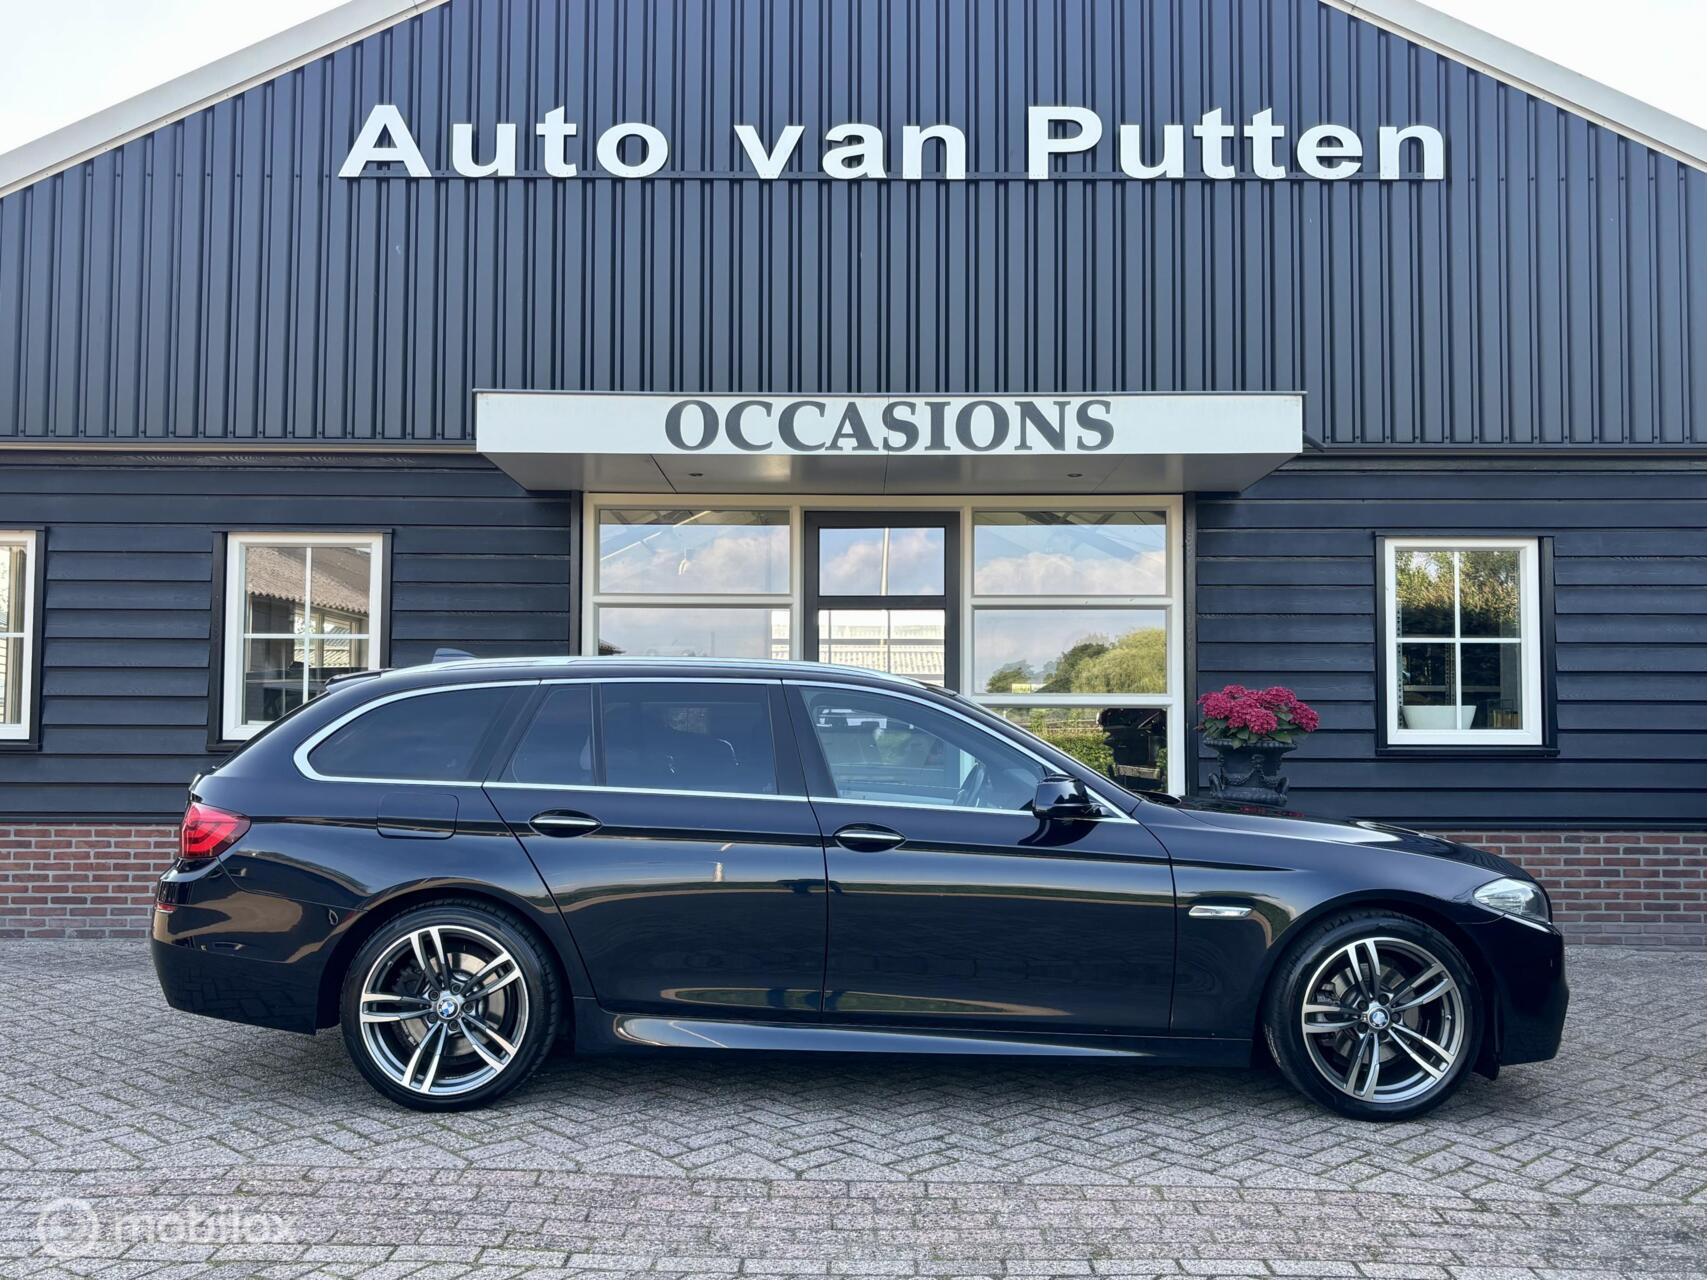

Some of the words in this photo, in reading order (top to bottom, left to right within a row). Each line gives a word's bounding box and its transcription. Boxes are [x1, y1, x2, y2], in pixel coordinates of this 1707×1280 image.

[338, 104, 669, 179] Auto
[733, 123, 967, 180] van
[1027, 105, 1445, 181] Putten
[665, 398, 1115, 452] OCCASIONS
